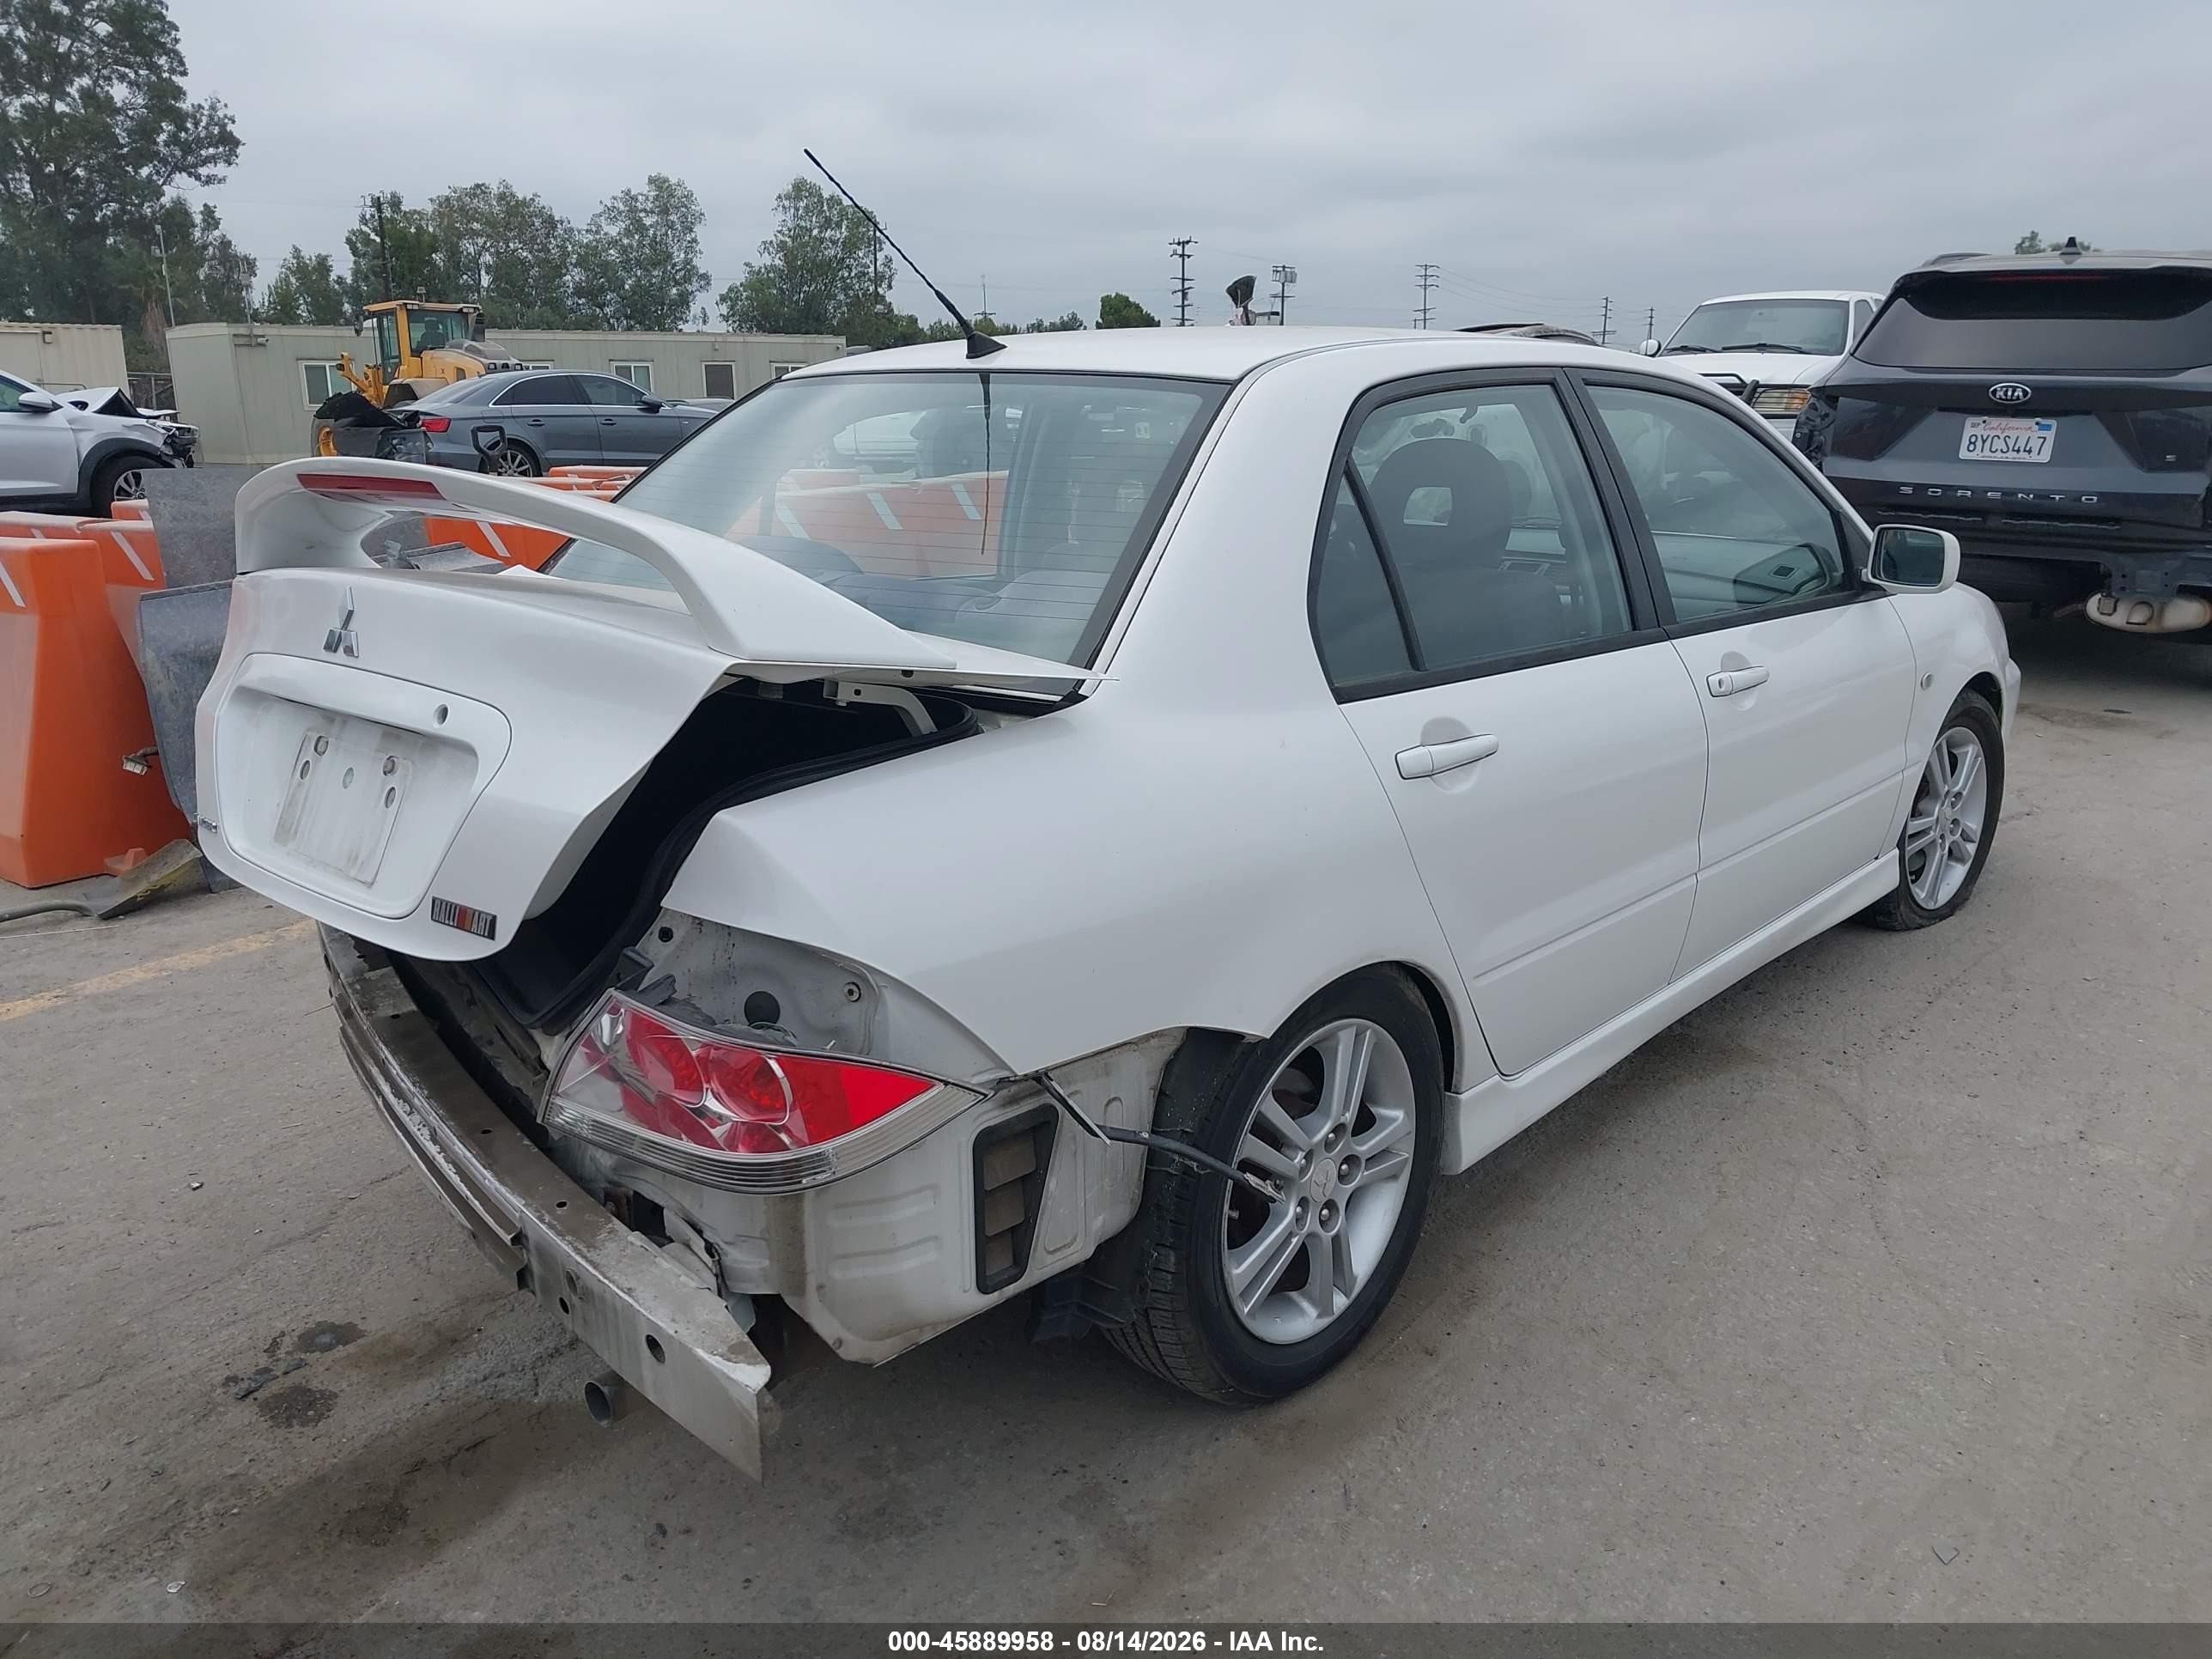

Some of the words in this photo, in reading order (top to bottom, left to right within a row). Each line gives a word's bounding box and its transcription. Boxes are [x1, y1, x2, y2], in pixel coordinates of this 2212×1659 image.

[1995, 387, 2025, 400] KIA
[1982, 421, 2039, 434] California
[1966, 434, 2047, 456] 8YCS447
[1899, 486, 2098, 504] SORENTO
